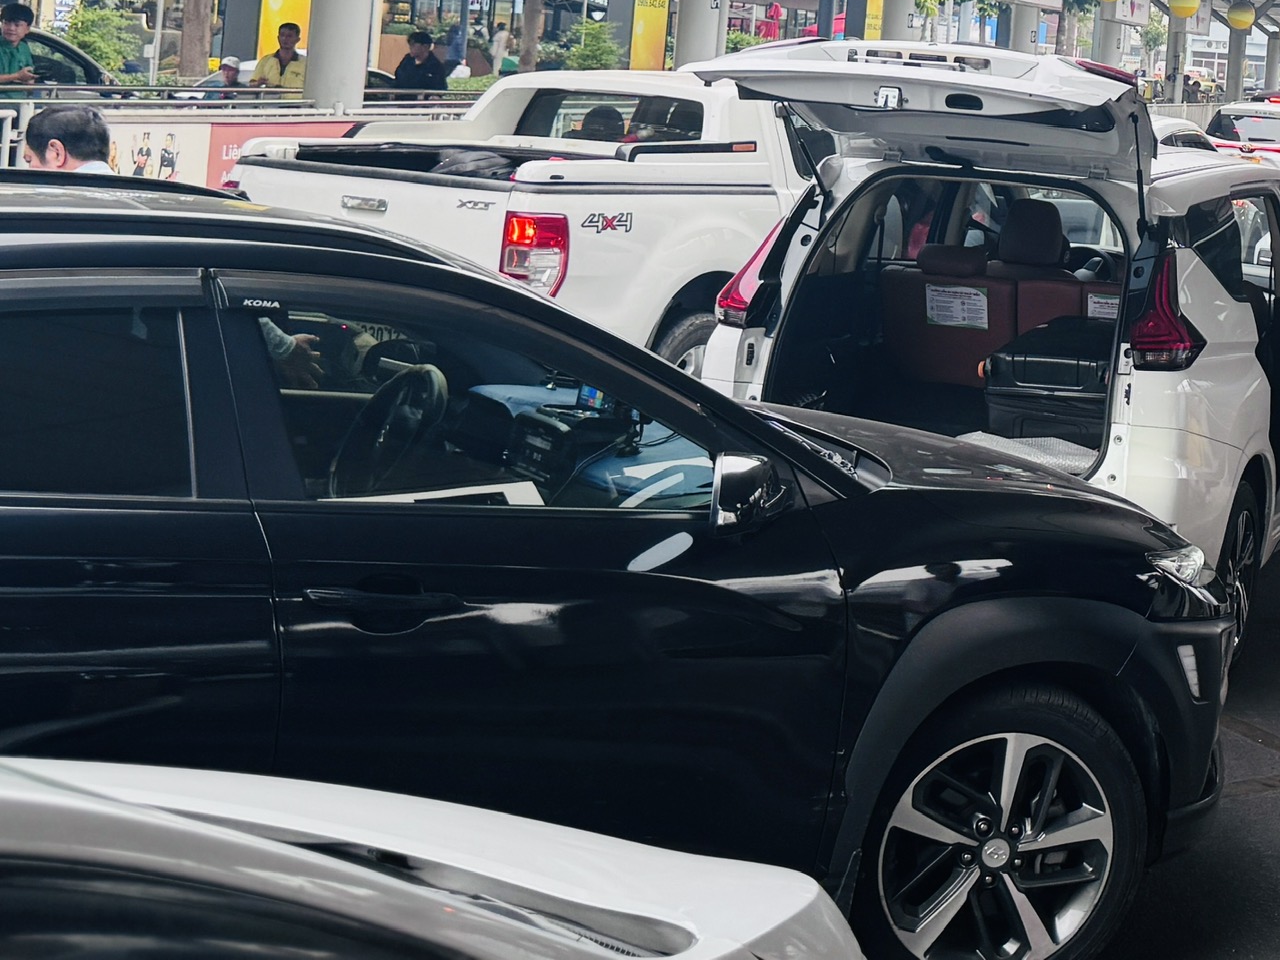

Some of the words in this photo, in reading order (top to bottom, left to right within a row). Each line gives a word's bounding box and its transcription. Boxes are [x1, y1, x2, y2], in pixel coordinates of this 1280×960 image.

[456, 199, 497, 211] XLT
[581, 212, 633, 234] 4x4
[243, 298, 281, 309] KONA
